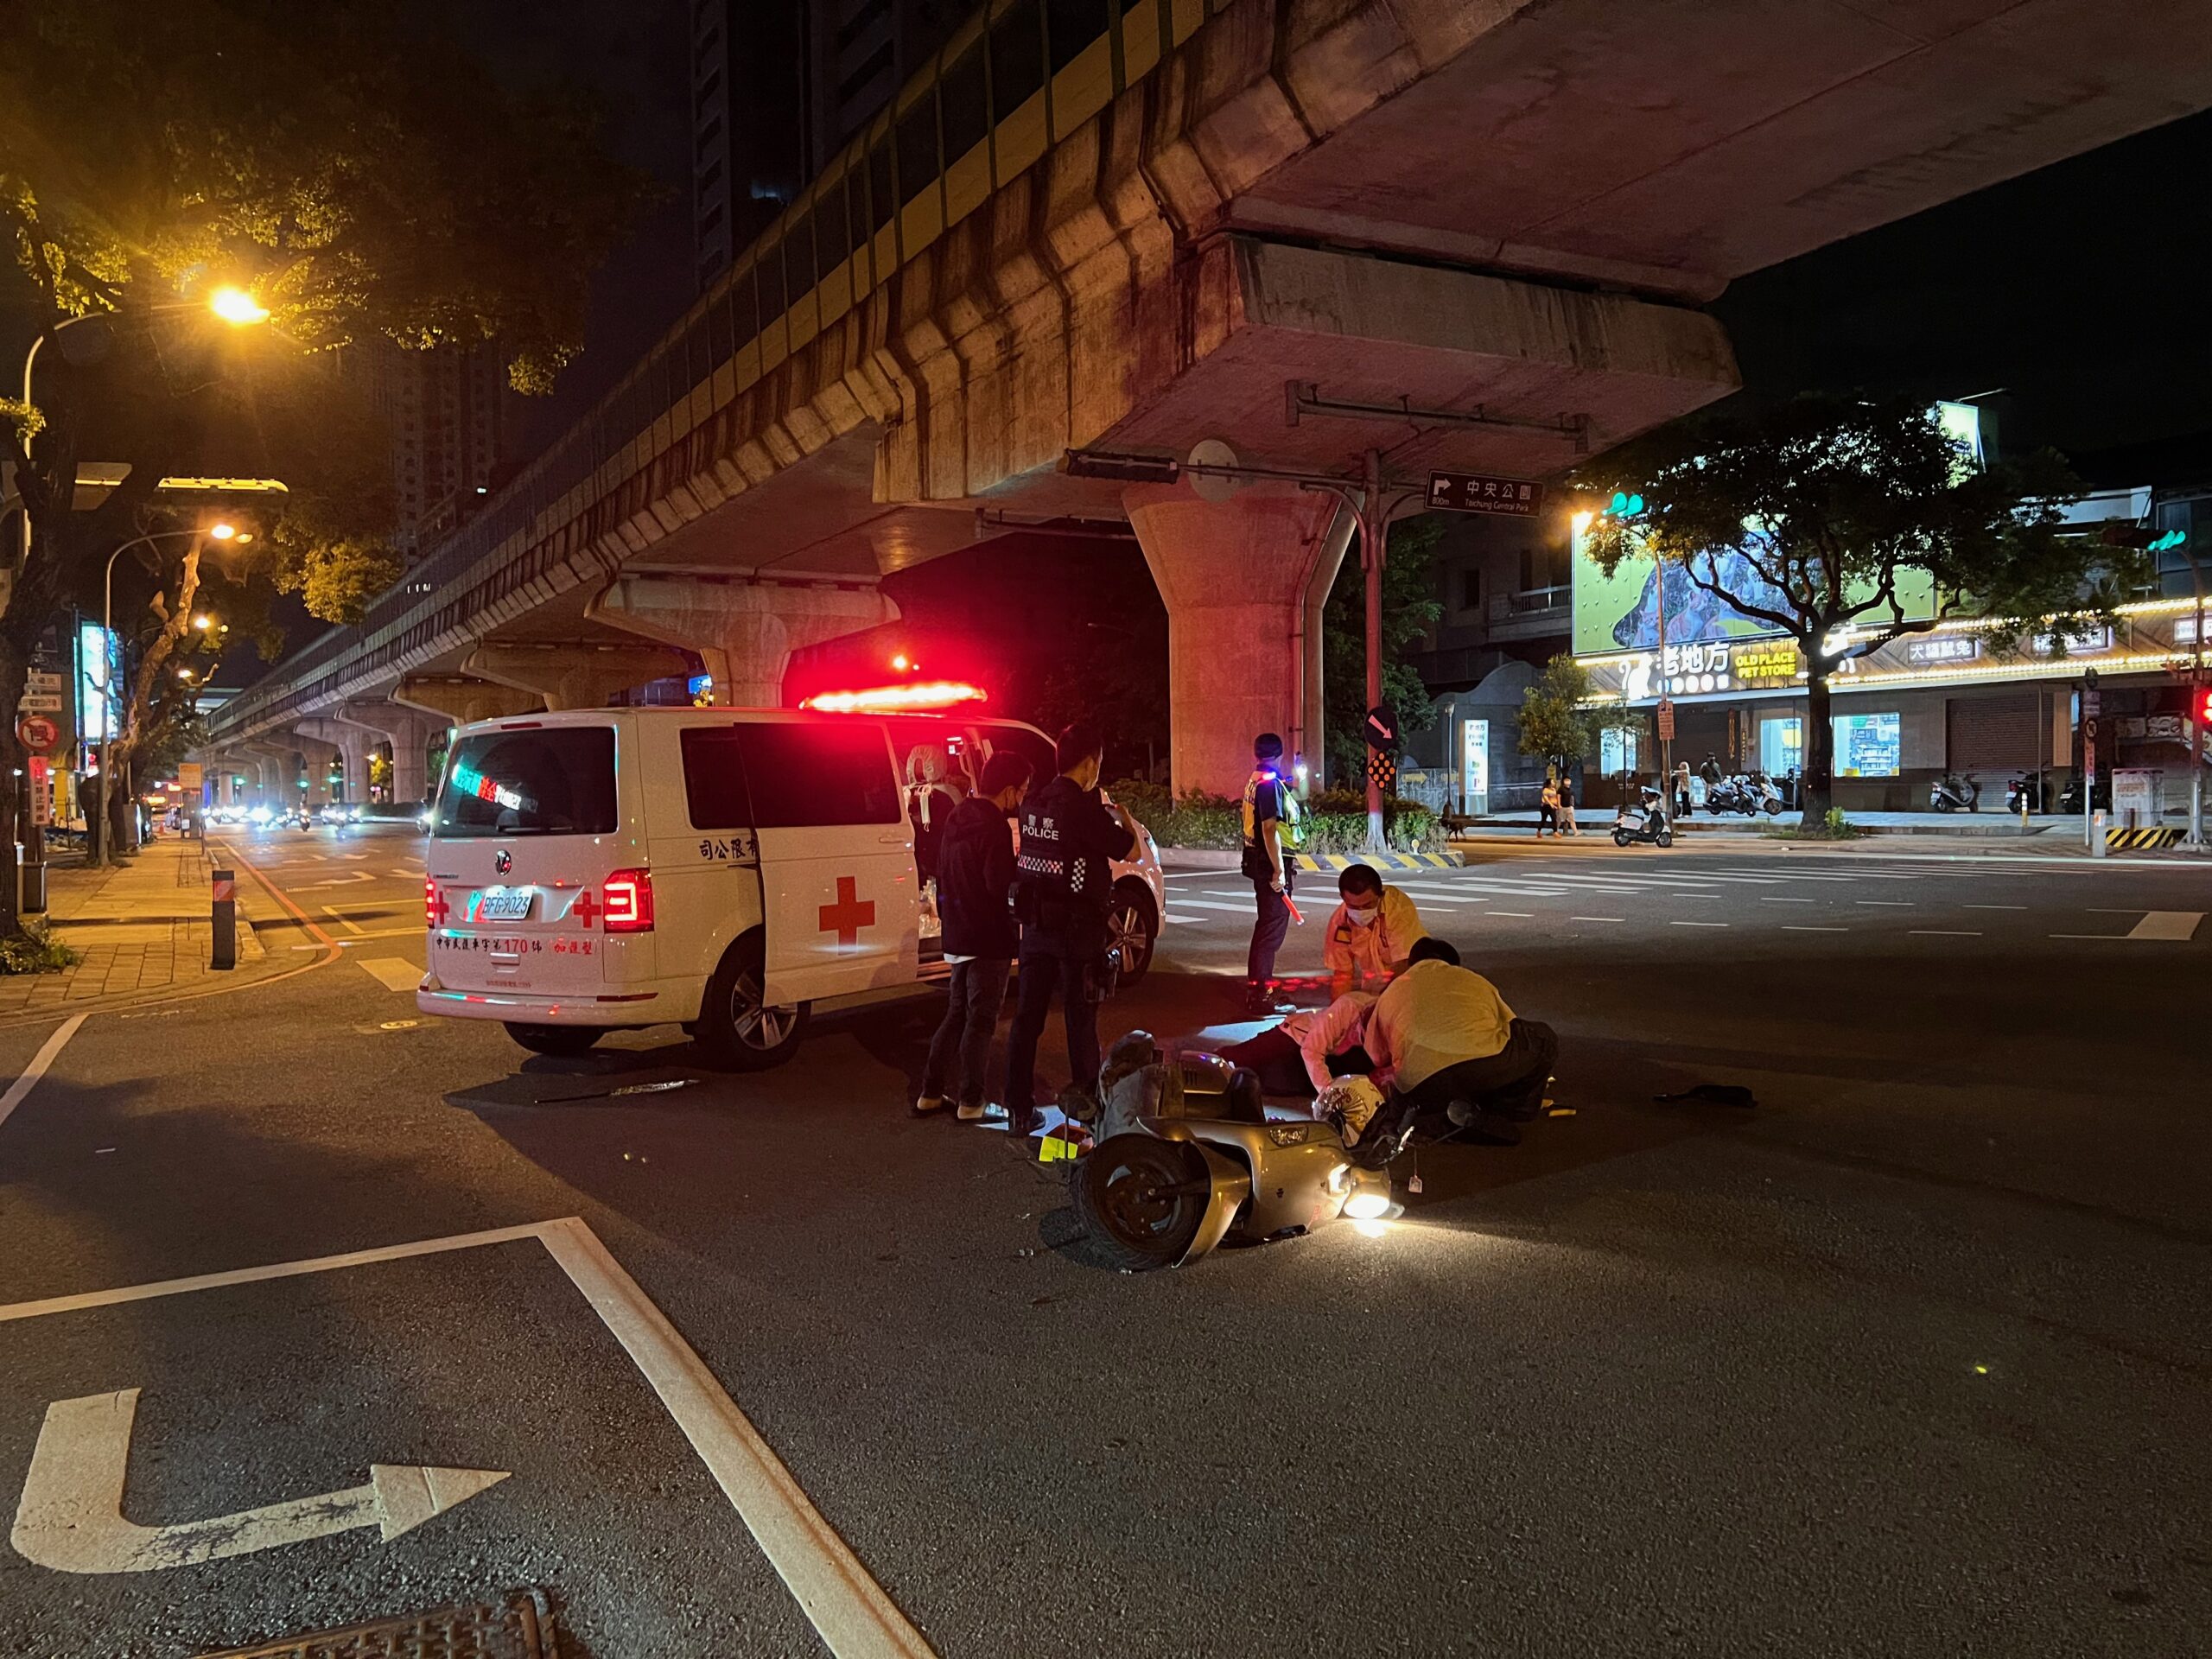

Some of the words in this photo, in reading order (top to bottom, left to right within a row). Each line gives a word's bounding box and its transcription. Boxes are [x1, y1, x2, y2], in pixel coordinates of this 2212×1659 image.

[1466, 480, 1531, 500] 中央公園
[1432, 496, 1450, 506] 800m
[1465, 498, 1492, 512] Taichung
[1493, 500, 1515, 512] Central
[1516, 503, 1529, 512] Park
[1735, 654, 1758, 667] OLD
[1758, 652, 1796, 665] PLACE
[1738, 665, 1759, 678] PET
[1759, 663, 1796, 677] STORE
[1022, 823, 1059, 841] POLICE
